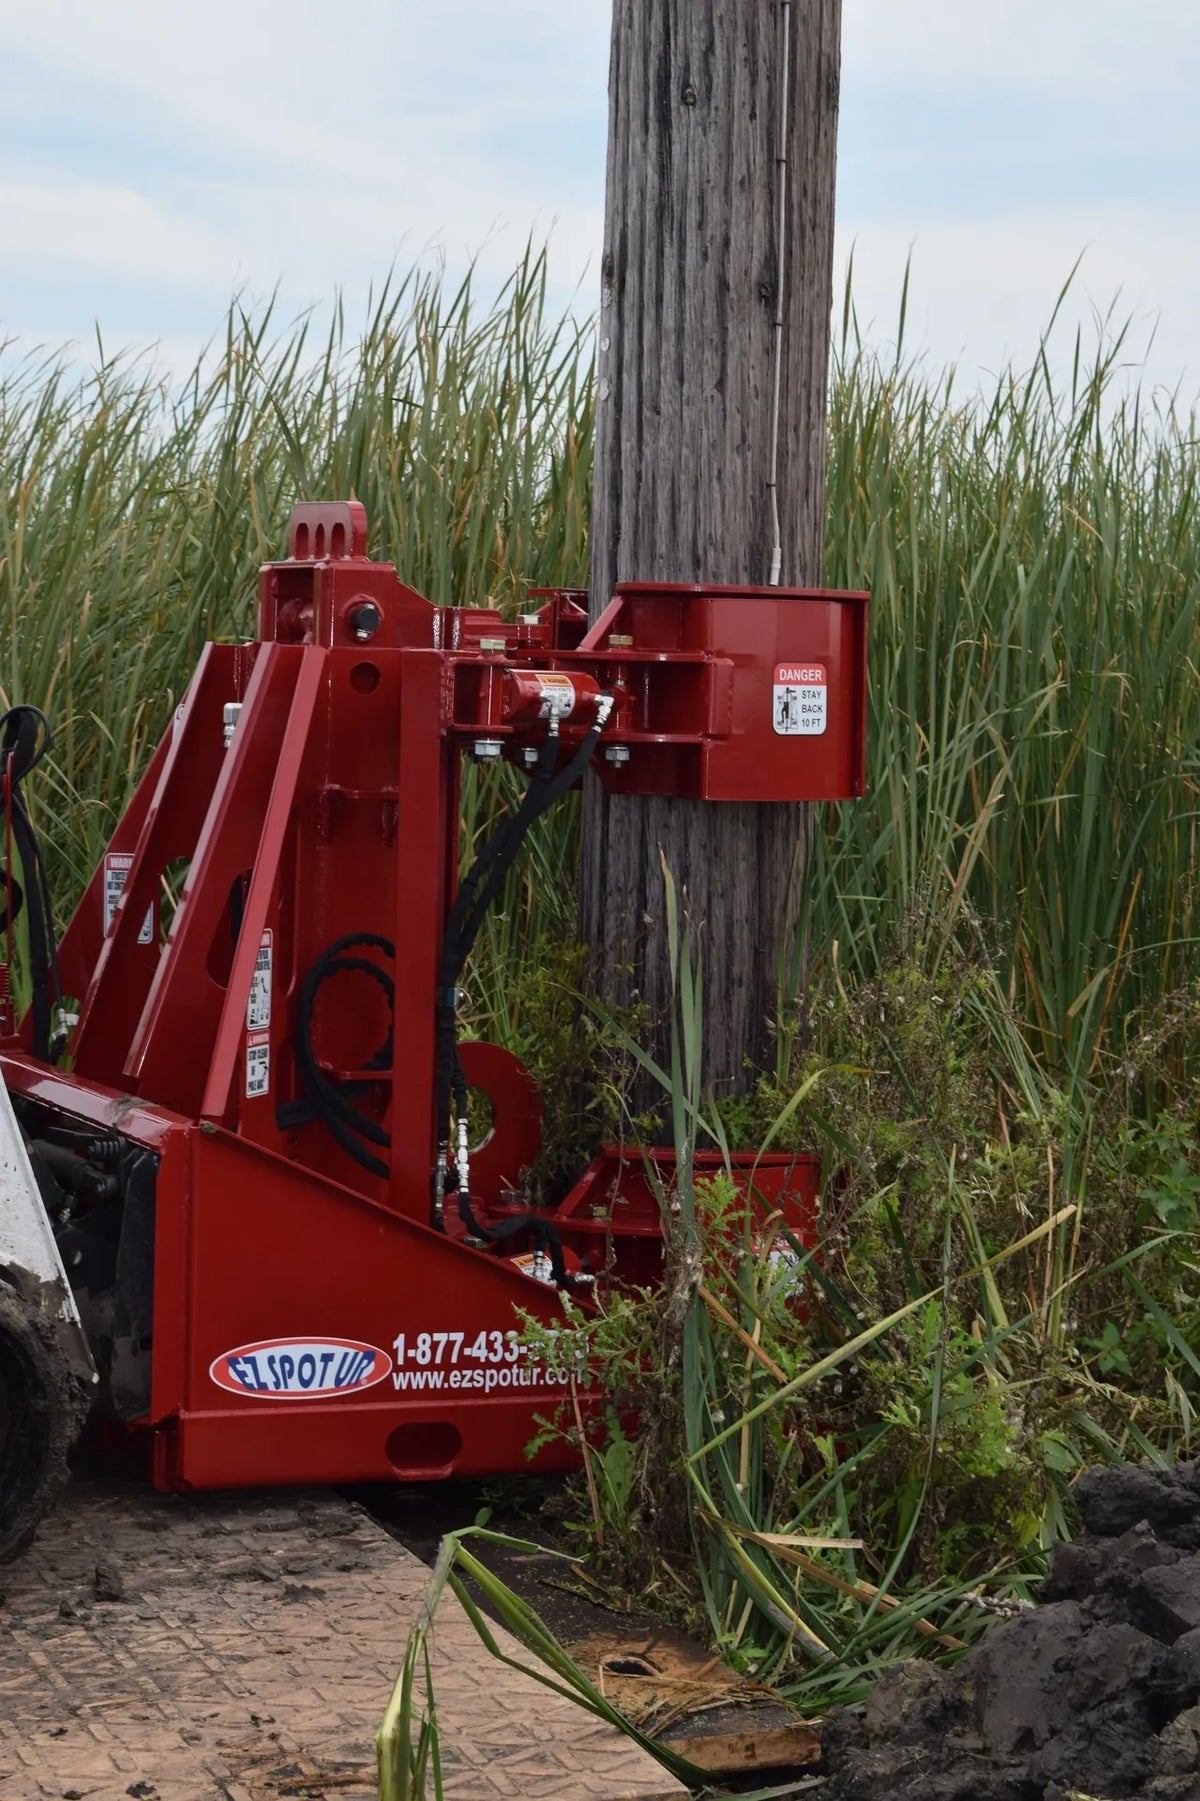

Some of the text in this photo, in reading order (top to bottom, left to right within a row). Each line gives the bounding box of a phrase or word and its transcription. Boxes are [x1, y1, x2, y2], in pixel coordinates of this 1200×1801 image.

[779, 668, 823, 681] DANGER
[801, 690, 822, 700] STAY
[801, 704, 824, 714] BACK
[802, 718, 822, 728] 10 FT
[392, 1330, 590, 1366] 1-877-433-
[226, 1356, 270, 1391] EZ
[334, 1351, 376, 1387] UR
